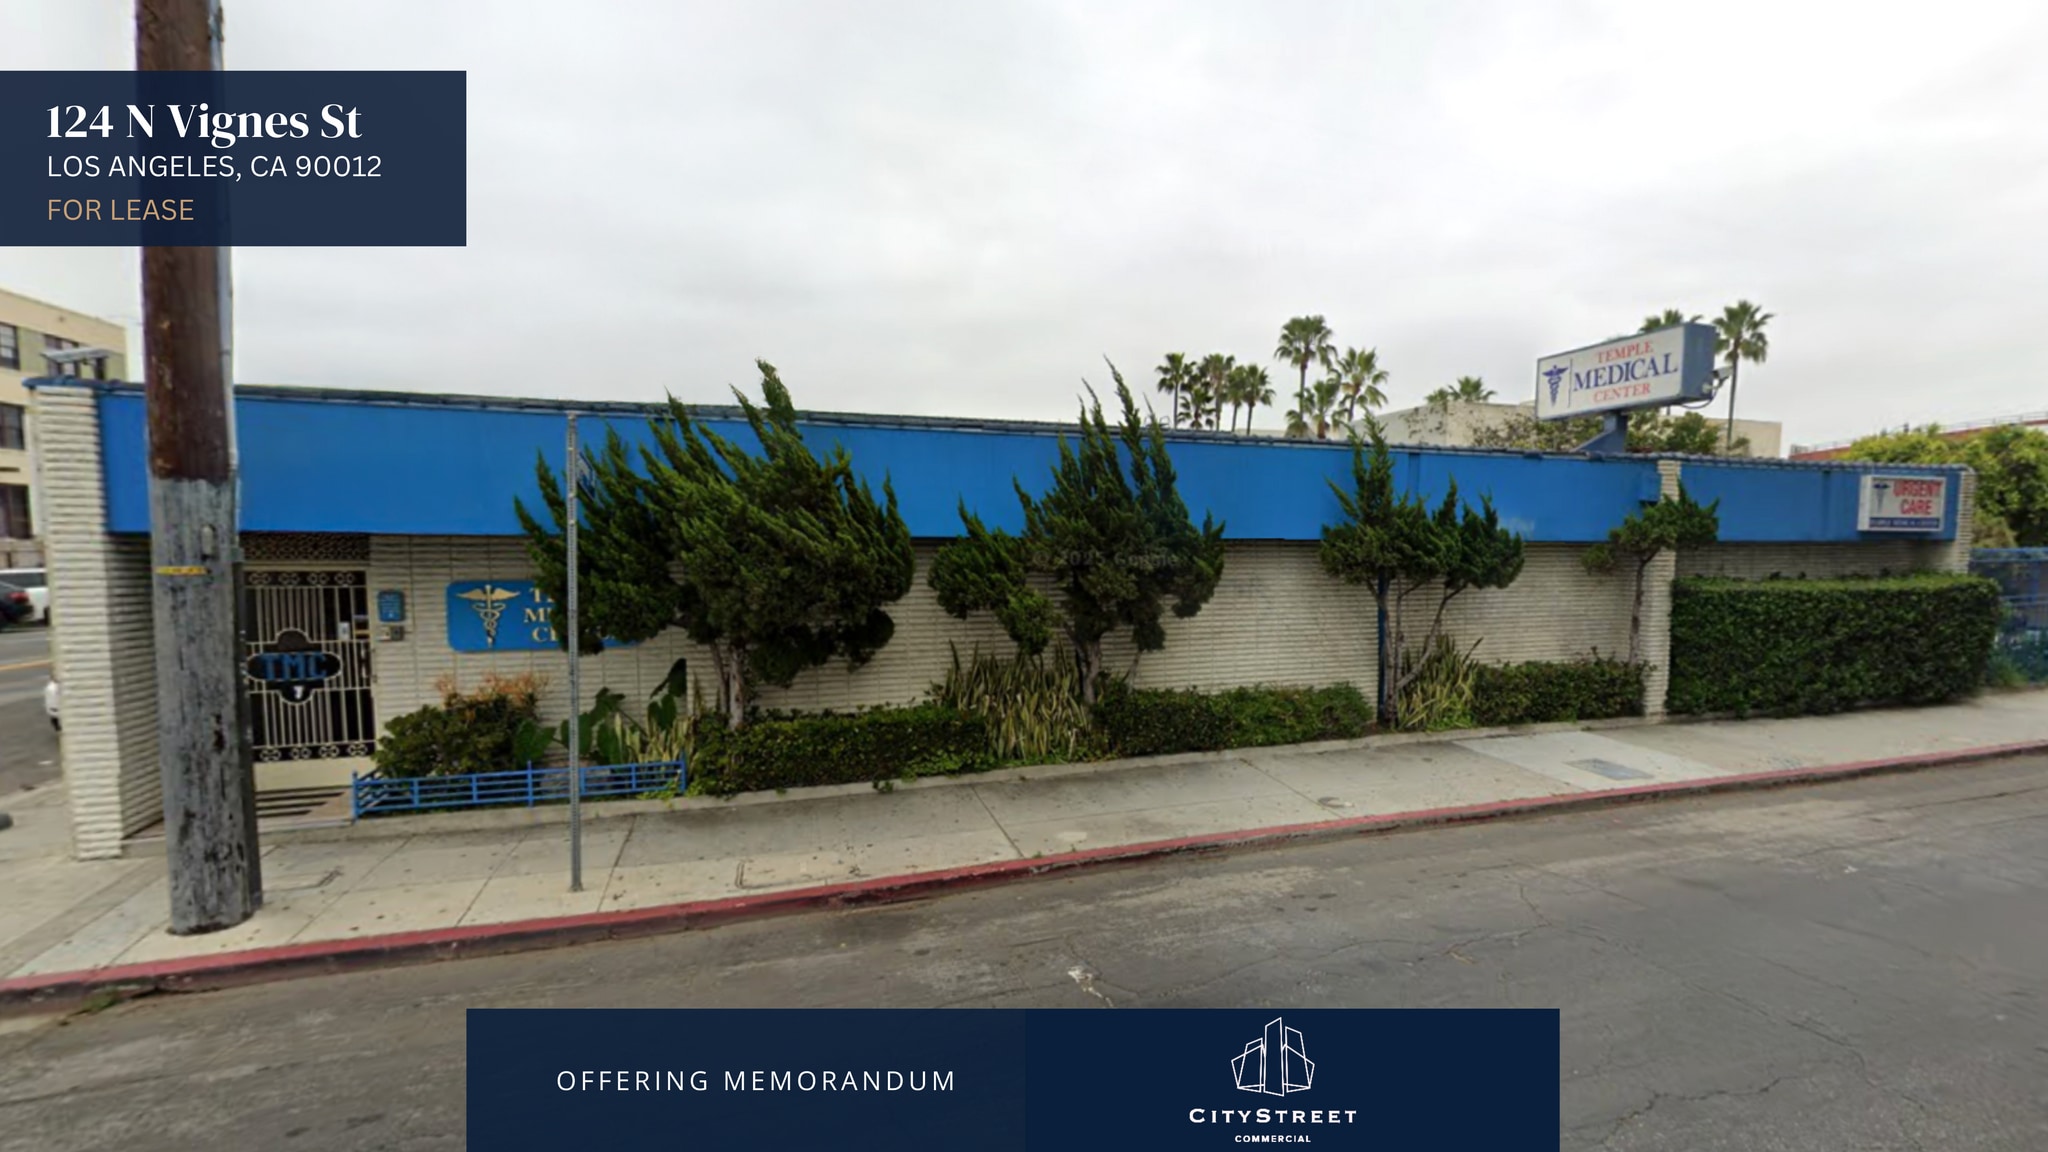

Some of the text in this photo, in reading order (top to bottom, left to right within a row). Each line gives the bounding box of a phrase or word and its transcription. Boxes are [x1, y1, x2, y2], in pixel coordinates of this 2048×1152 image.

[1598, 340, 1654, 363] TEMPLE
[1573, 353, 1678, 392] MEDICAL
[1593, 383, 1651, 403] CENTER
[1893, 480, 1942, 497] URGENT
[1901, 499, 1931, 515] CARE
[260, 652, 327, 680] TMC
